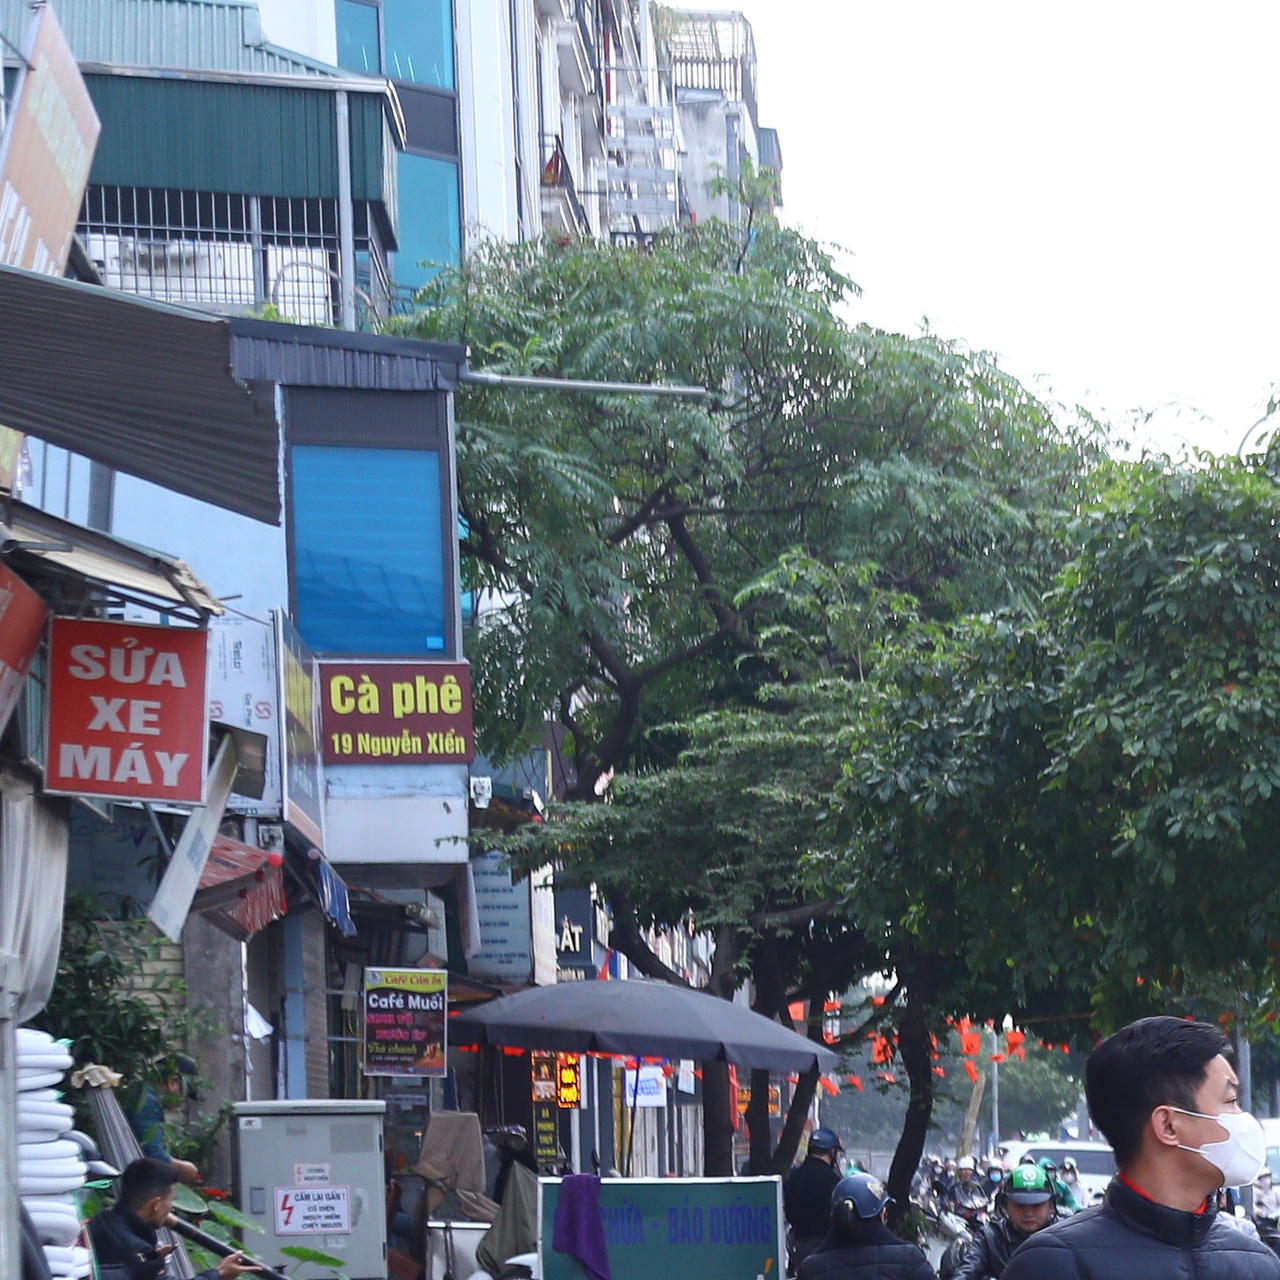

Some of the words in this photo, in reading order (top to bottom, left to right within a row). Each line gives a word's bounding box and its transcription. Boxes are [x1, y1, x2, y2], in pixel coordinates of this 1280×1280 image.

[69, 637, 186, 688] SỬA
[87, 696, 161, 735] XE
[330, 674, 380, 714] Cà
[392, 674, 462, 719] phê
[331, 732, 353, 754] 19
[357, 728, 422, 757] Nguyễn
[59, 742, 189, 787] MÁY
[368, 991, 404, 1009] Café
